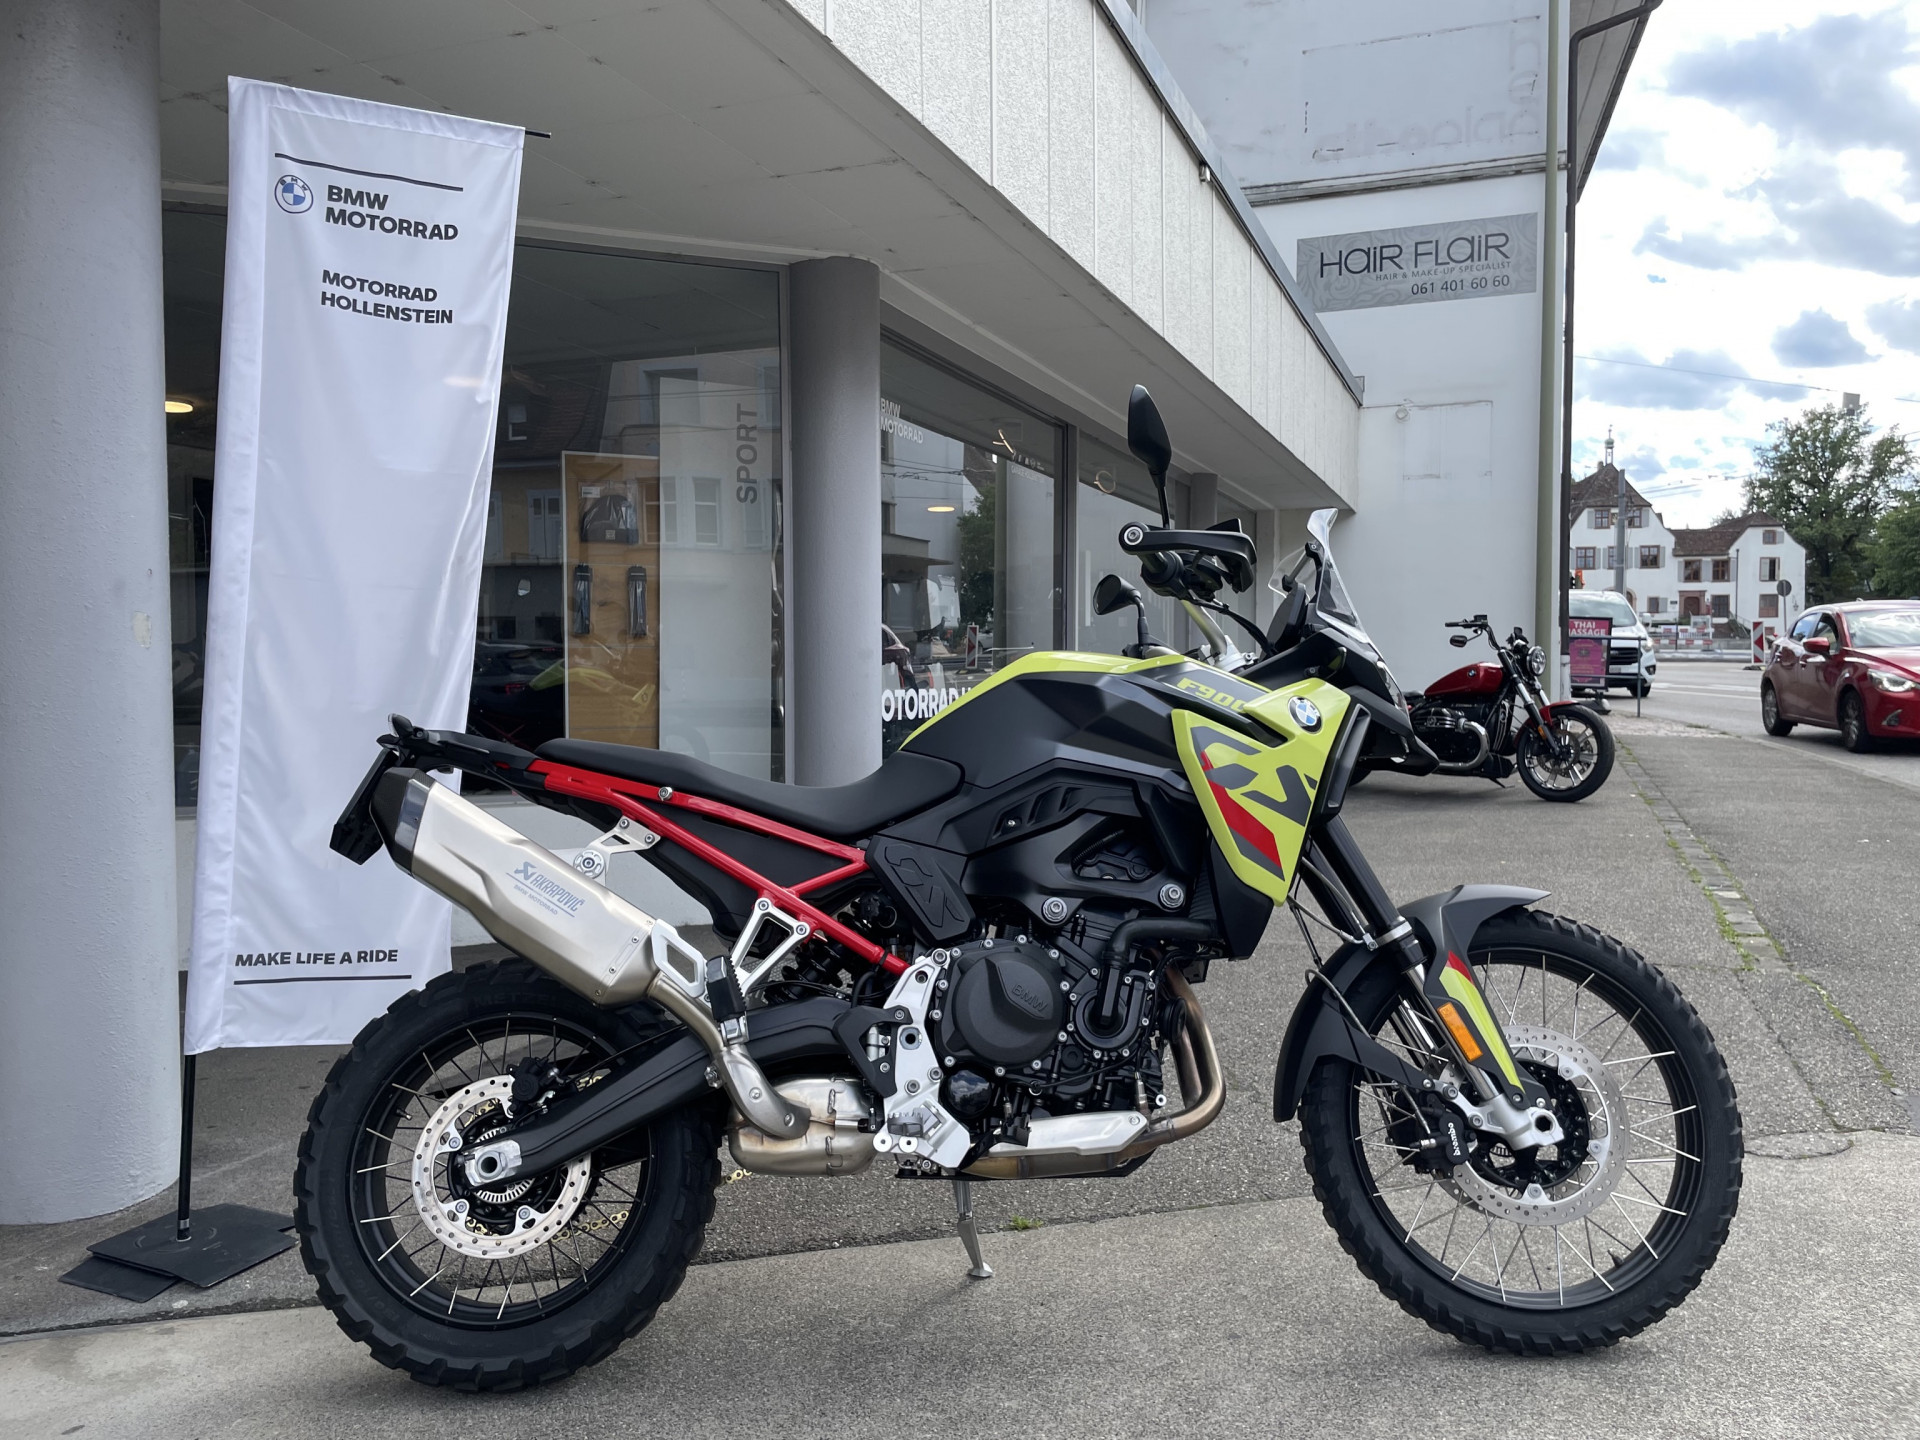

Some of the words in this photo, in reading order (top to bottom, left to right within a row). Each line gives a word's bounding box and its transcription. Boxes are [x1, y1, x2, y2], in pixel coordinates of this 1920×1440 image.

[327, 184, 389, 211] BMW
[325, 206, 459, 241] MOTORRAD
[1375, 272, 1399, 282] HAIR
[1401, 270, 1408, 279] &
[1411, 265, 1456, 279] MAKE-UP
[1458, 260, 1512, 274] SPECIALIST
[1411, 281, 1436, 296] 061
[1440, 278, 1465, 292] 401
[1470, 276, 1488, 290] 60
[1492, 273, 1510, 287] 60
[322, 269, 438, 302] MOTORRAD
[321, 291, 453, 324] HOLLENSTEIN
[880, 397, 901, 418] BMW
[880, 415, 924, 444] MOTORRAD
[736, 403, 757, 504] SPORT
[1568, 628, 1606, 636] ASSAGE
[1574, 621, 1596, 629] THAI
[882, 687, 959, 722] OTORRAD
[527, 892, 558, 916] MOTORRAD
[235, 952, 291, 966] MAKE
[296, 952, 335, 965] LIFE
[339, 951, 352, 964] A
[357, 949, 398, 963] RIDE
[1448, 1122, 1460, 1155] brembo
